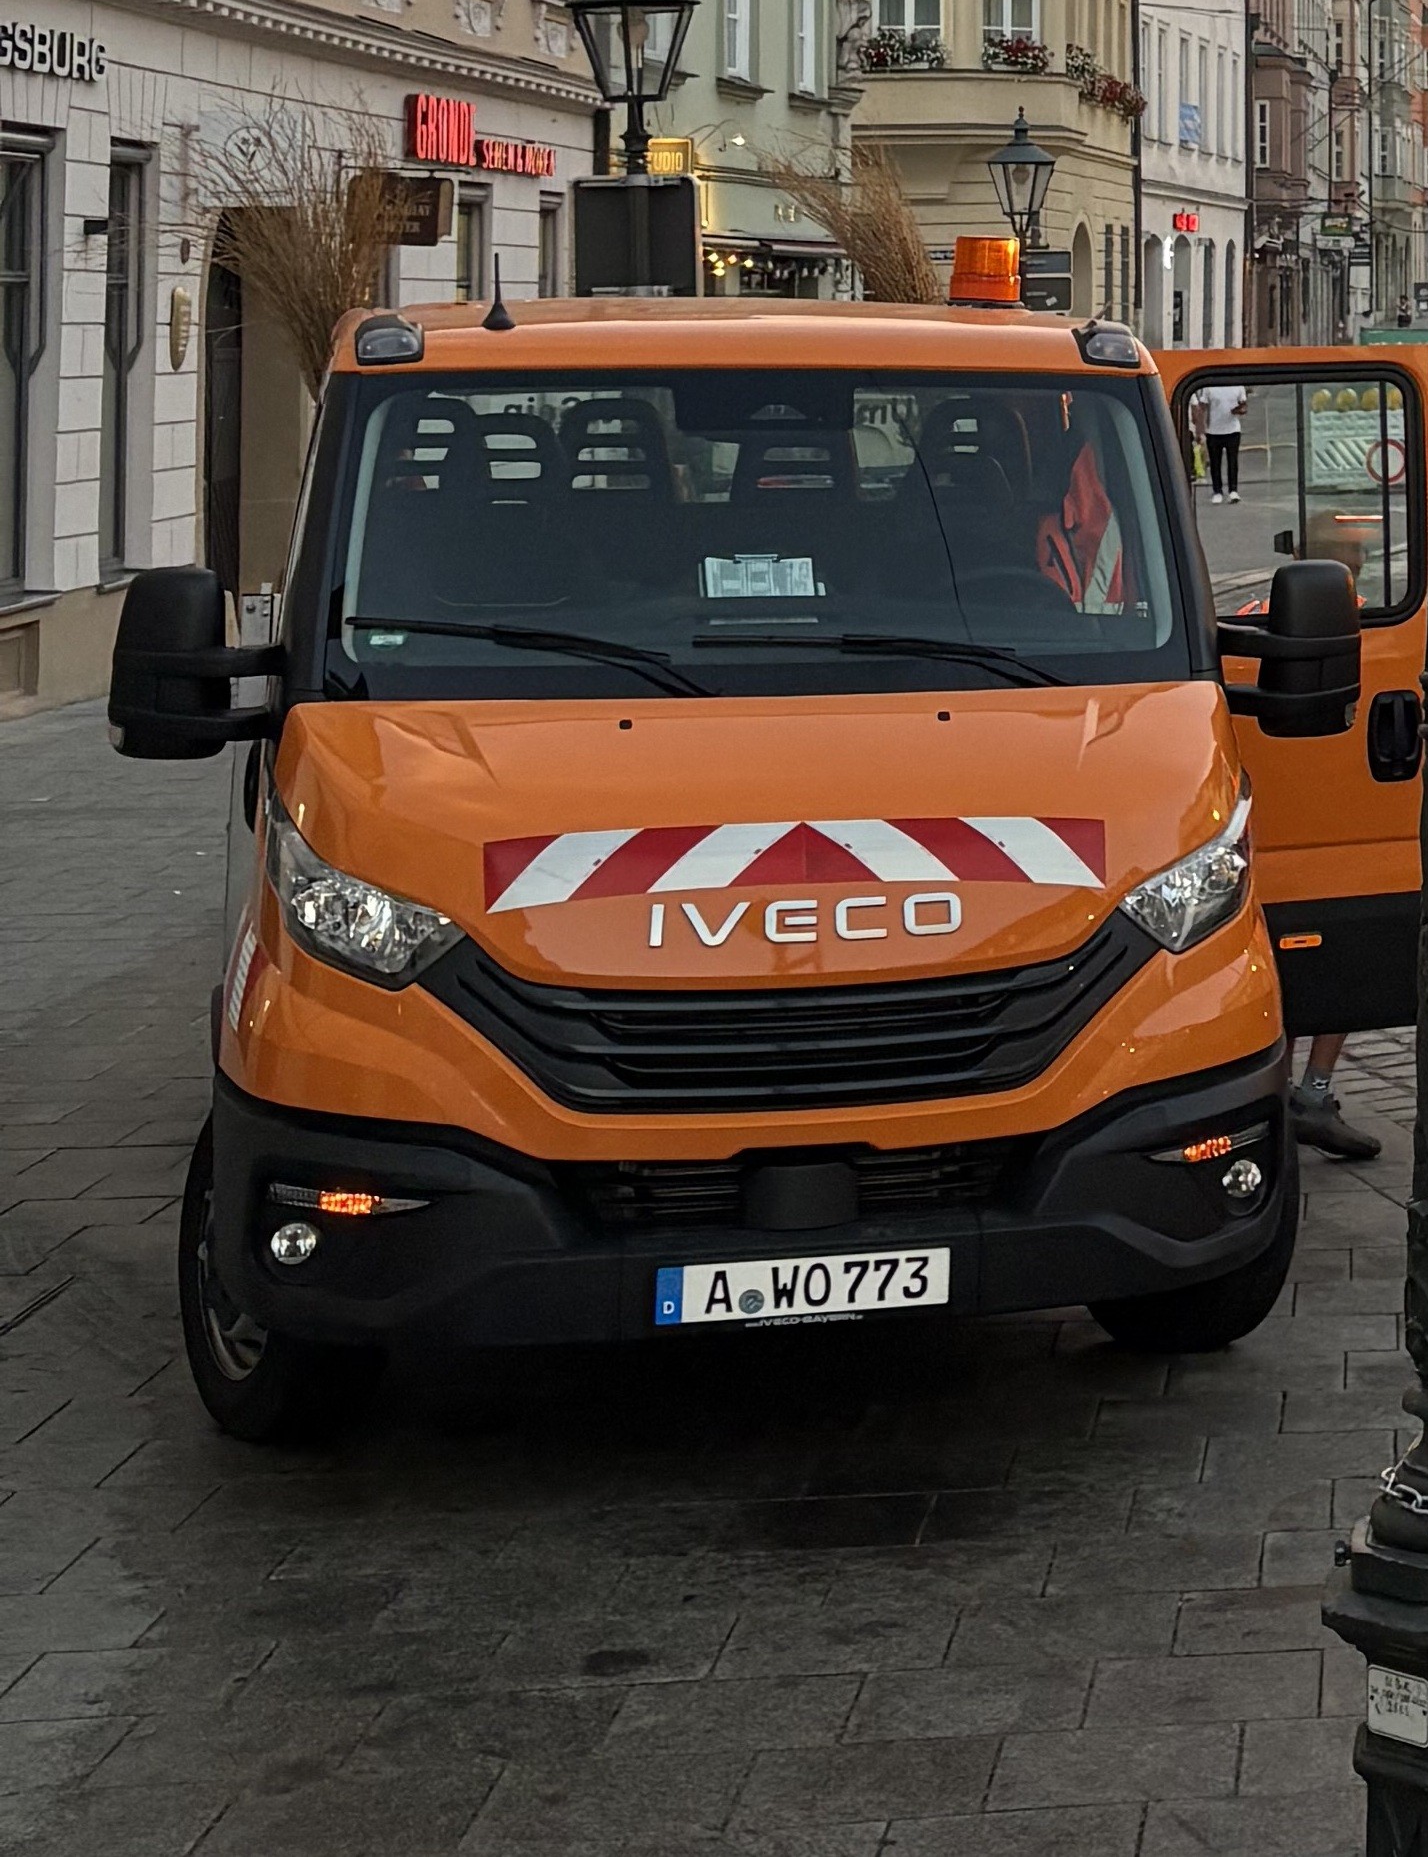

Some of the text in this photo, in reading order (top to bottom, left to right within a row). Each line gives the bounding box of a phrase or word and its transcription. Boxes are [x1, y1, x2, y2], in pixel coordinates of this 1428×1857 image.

[416, 93, 476, 166] GRONDE
[648, 892, 962, 947] IVECO
[663, 1301, 674, 1315] D
[704, 1270, 733, 1314] A
